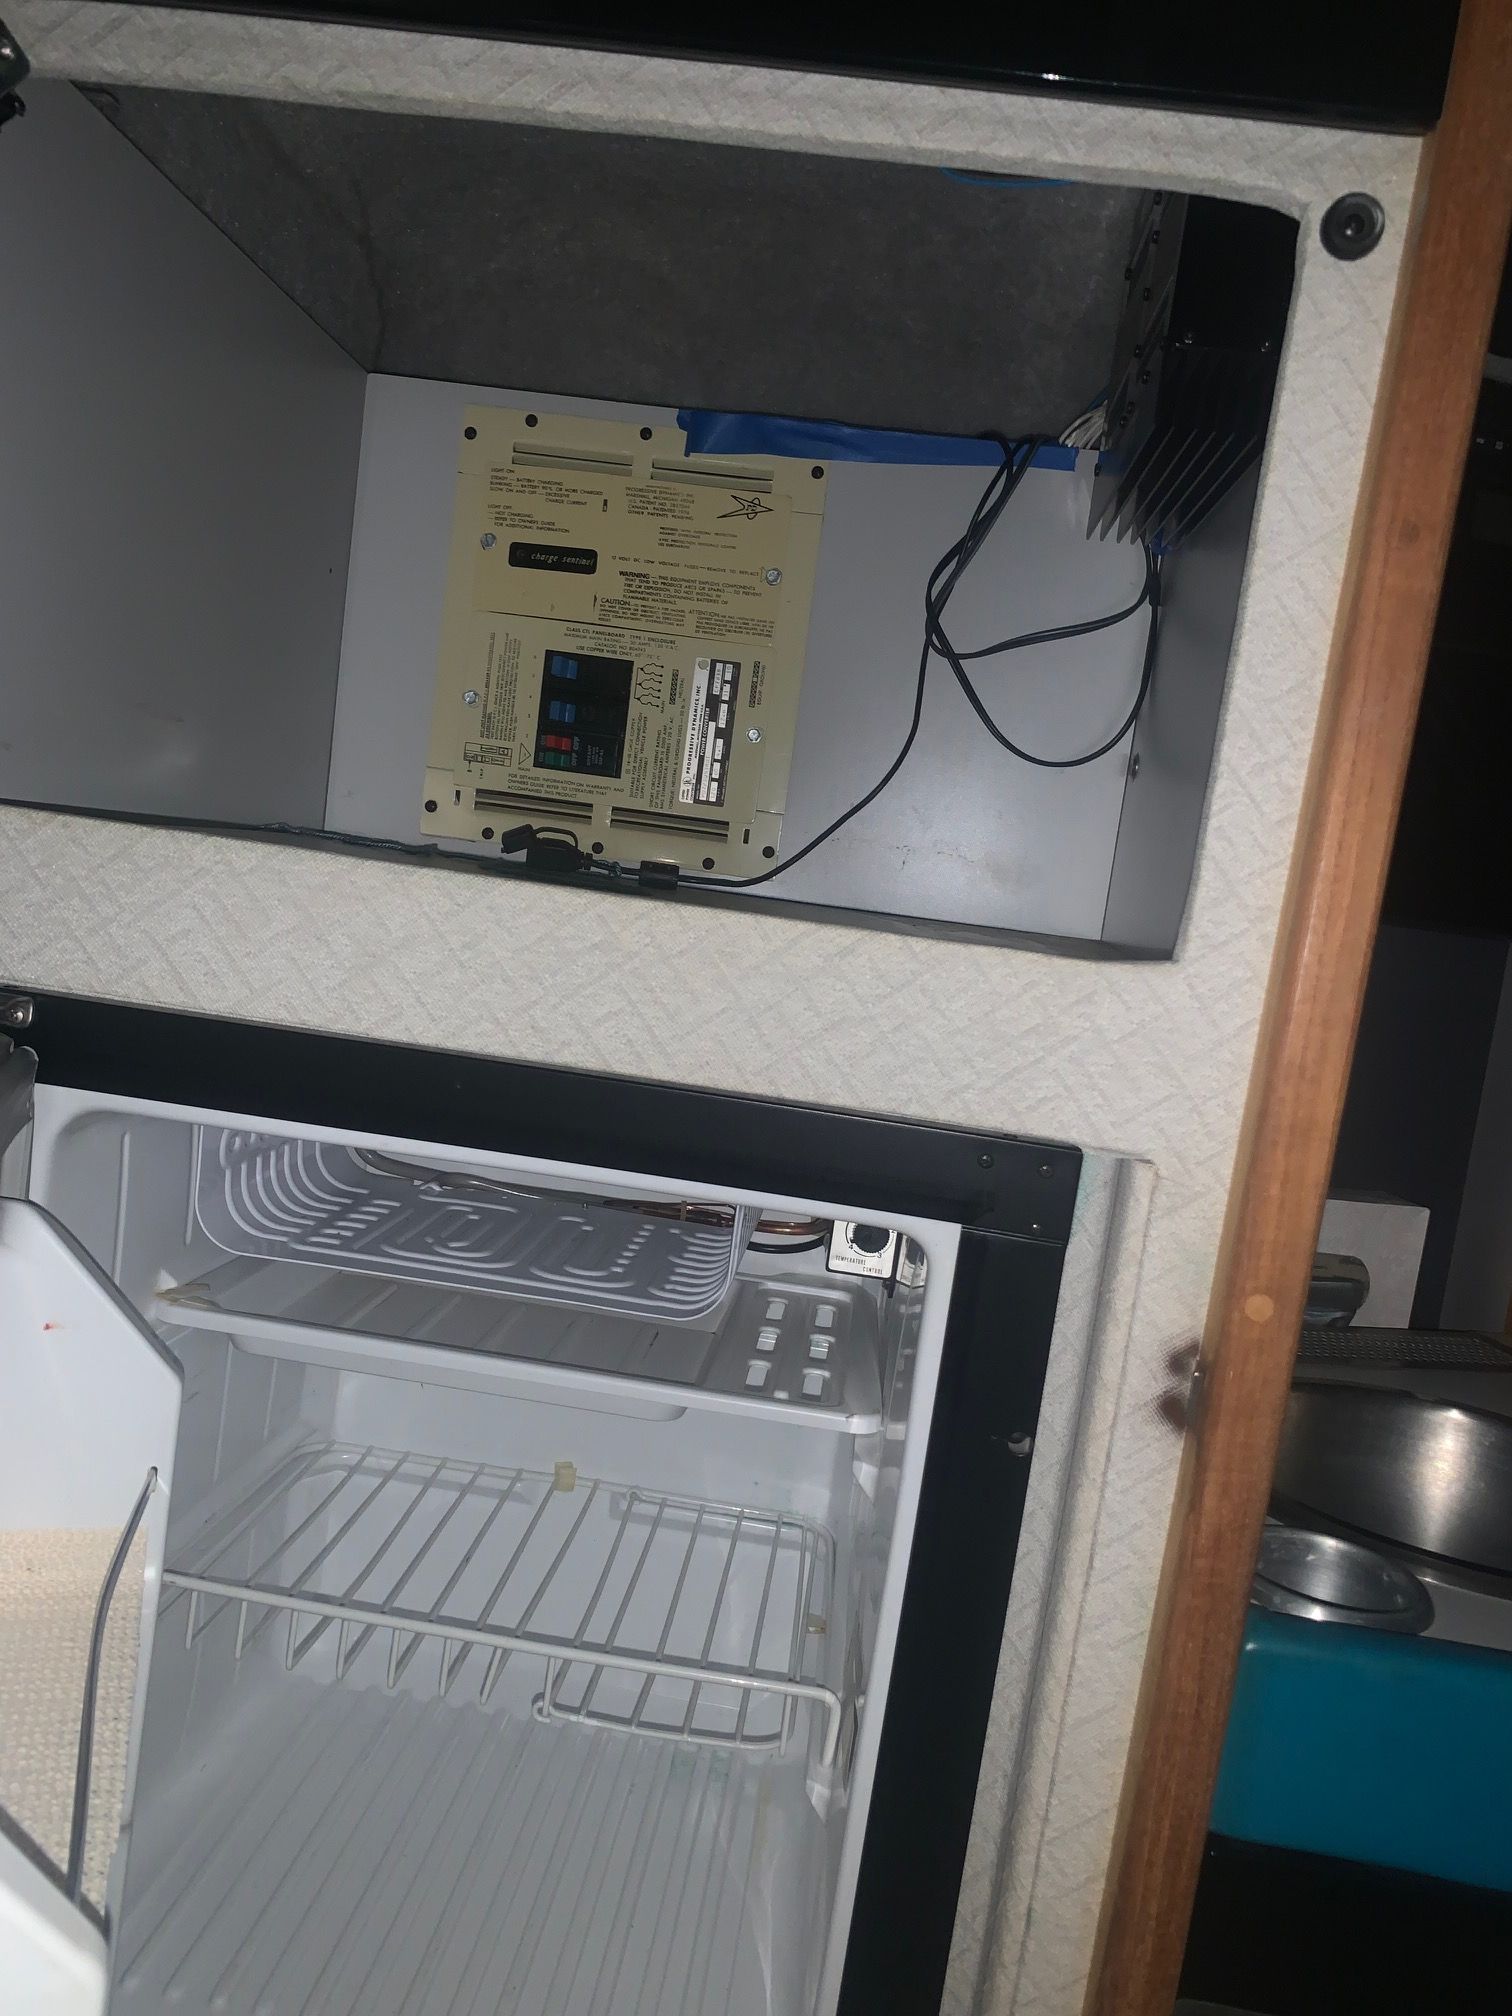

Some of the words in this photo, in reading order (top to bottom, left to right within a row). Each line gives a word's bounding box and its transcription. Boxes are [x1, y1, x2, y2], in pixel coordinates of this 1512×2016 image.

[531, 552, 559, 564] charge
[562, 555, 595, 566] sentinel
[618, 571, 650, 579] WARNING
[572, 736, 580, 750] OFF
[685, 733, 696, 775] PROGRESSIVE
[835, 1255, 866, 1265] TEMPERATURE
[862, 1266, 883, 1275] CONTROL
